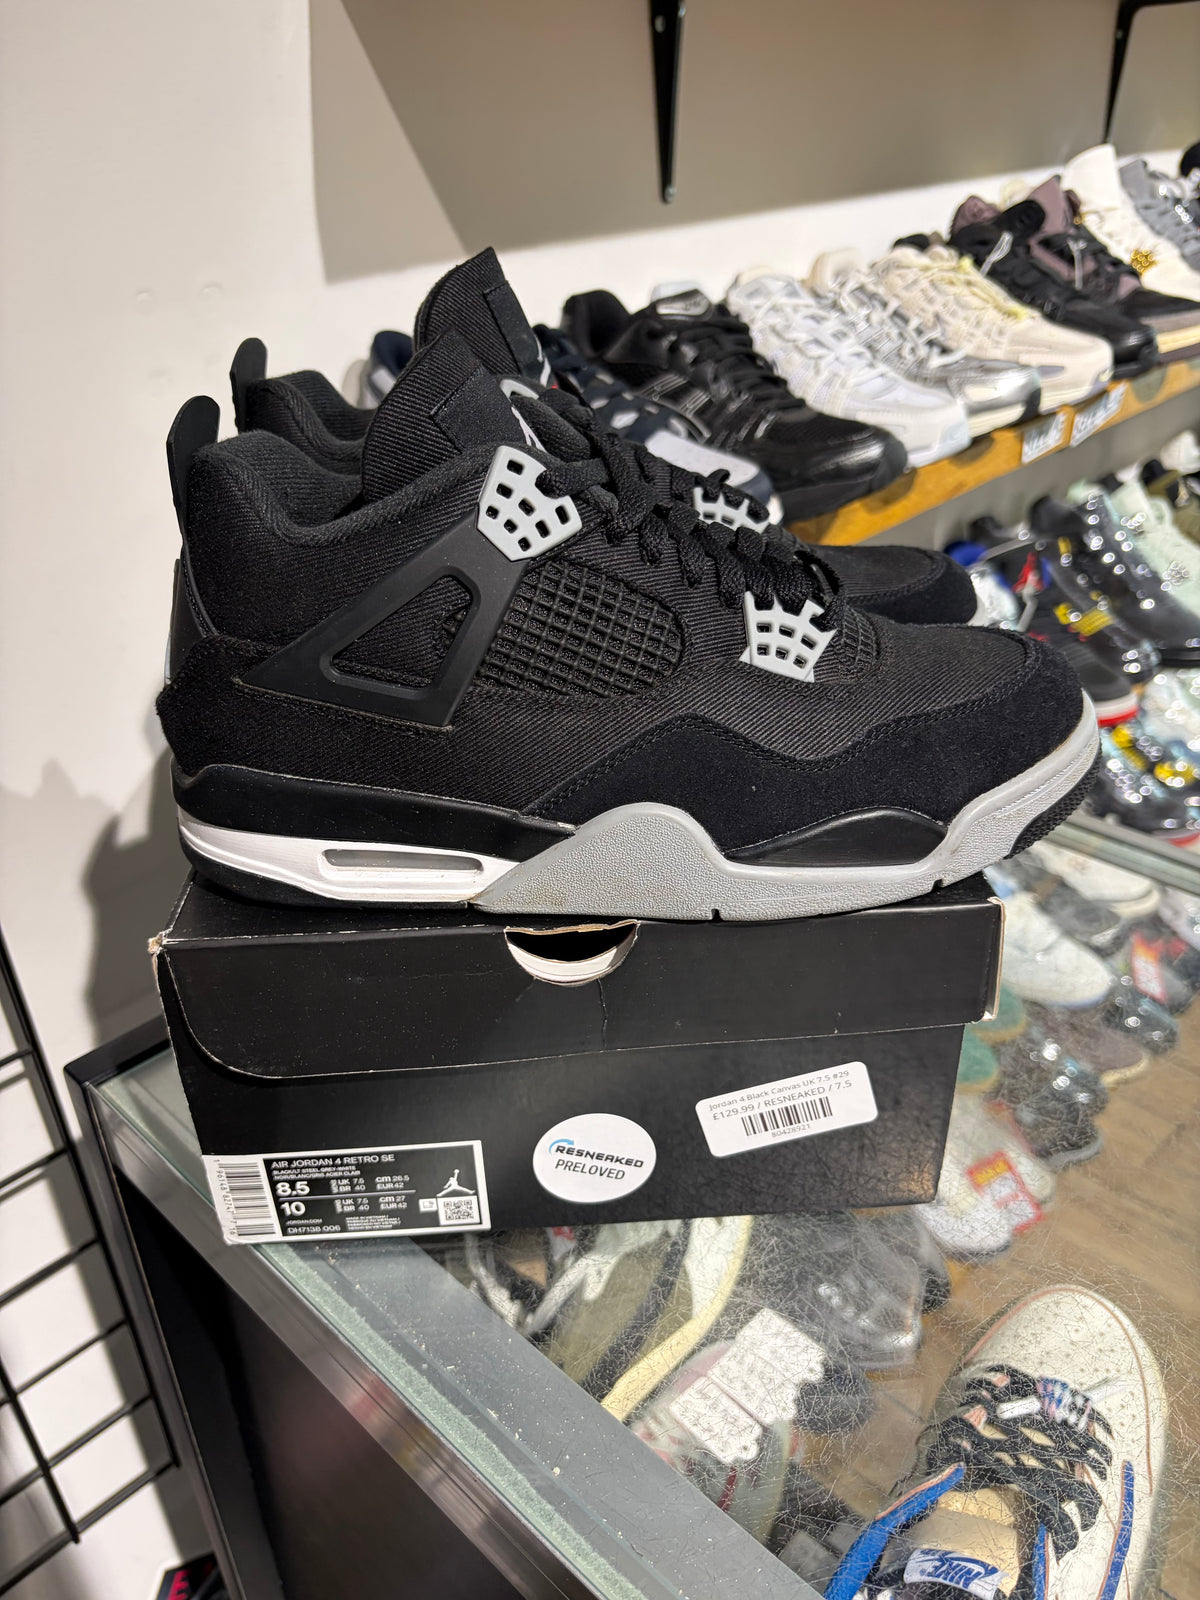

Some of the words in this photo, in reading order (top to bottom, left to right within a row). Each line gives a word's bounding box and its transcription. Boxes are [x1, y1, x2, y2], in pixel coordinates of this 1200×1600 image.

[709, 1097, 738, 1112] Jordan
[739, 1096, 745, 1104] 4
[746, 1090, 769, 1102] Black
[771, 1083, 801, 1096] Canvas
[802, 1079, 815, 1088] UK
[816, 1075, 831, 1085] 7.5
[832, 1070, 850, 1080] #29
[712, 1103, 755, 1121] £129.99
[764, 1086, 826, 1108] RESNEAKED
[835, 1080, 852, 1091] 7.5
[771, 1123, 811, 1138] 80428921
[271, 1160, 289, 1169] AIR
[290, 1158, 333, 1168] JORDAN
[334, 1157, 341, 1165] 4
[343, 1155, 379, 1164] RETRO
[381, 1154, 395, 1162] SE
[555, 1145, 644, 1168] RESNEAKED
[555, 1158, 626, 1180] PRELOVED
[275, 1180, 310, 1197] 8.5
[338, 1178, 350, 1186] UK
[338, 1184, 351, 1192] BR
[376, 1182, 393, 1190] EUR
[280, 1201, 306, 1217] 10
[342, 1198, 354, 1206] UK
[342, 1204, 356, 1212] BR
[287, 1226, 321, 1235] DH7138
[322, 1225, 341, 1233] 006
[926, 1559, 982, 1589] NIKE
